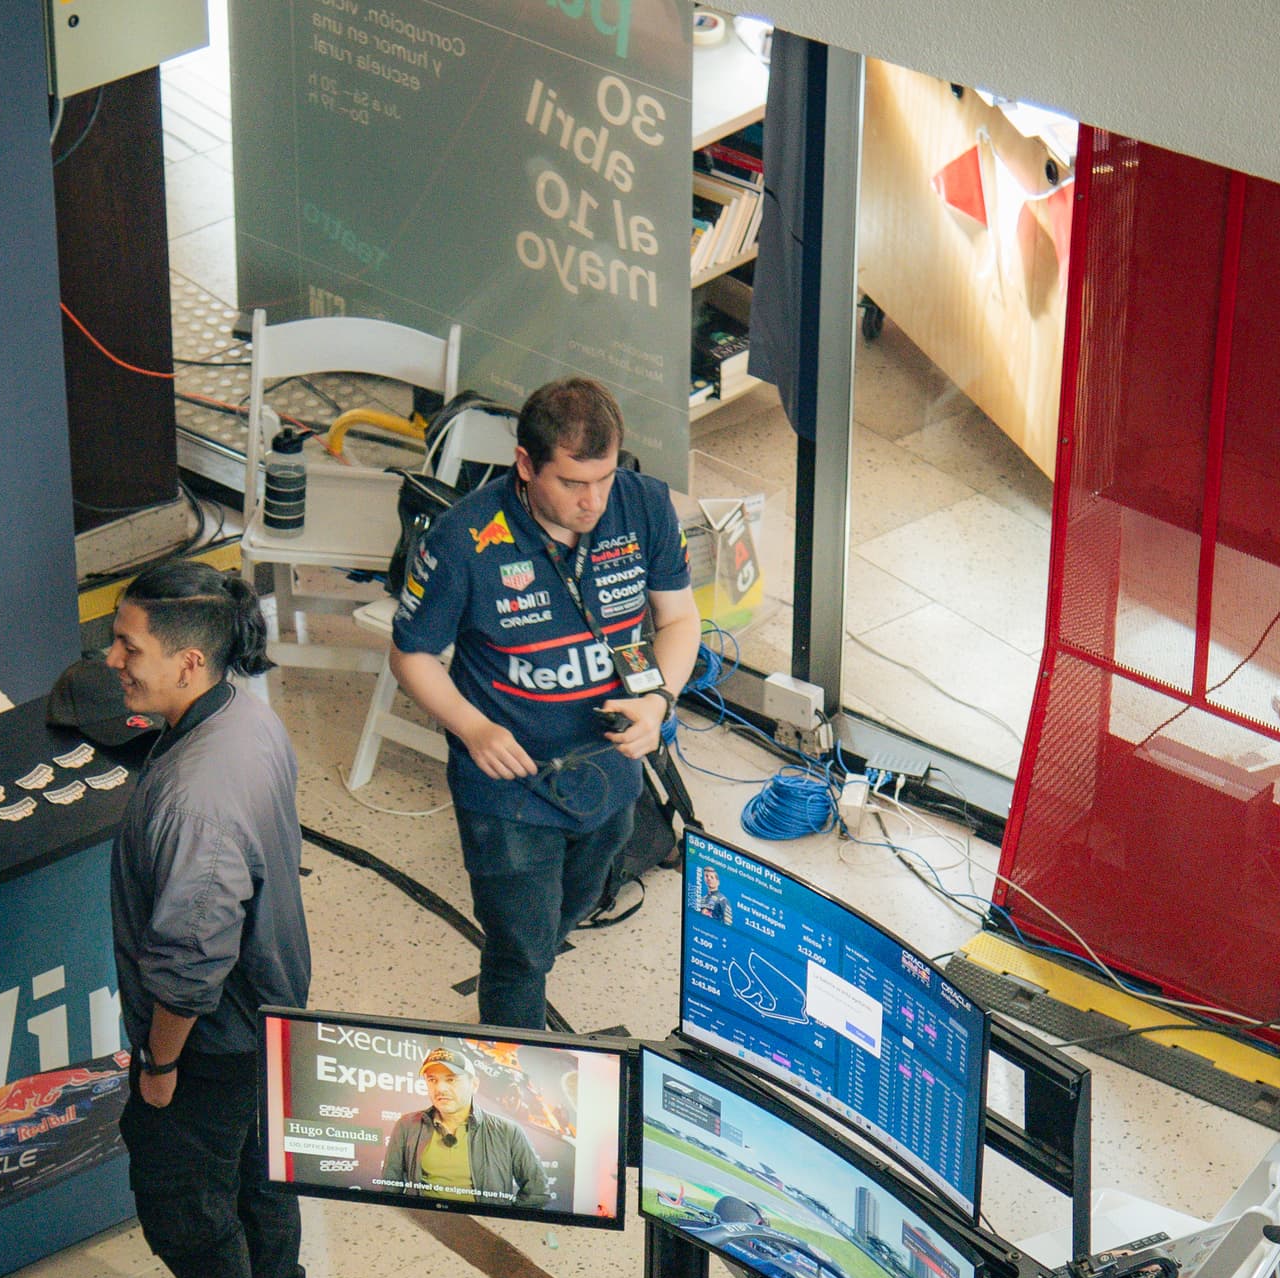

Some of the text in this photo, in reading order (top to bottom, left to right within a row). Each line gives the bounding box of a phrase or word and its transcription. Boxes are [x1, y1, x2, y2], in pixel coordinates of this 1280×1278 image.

[503, 563, 531, 575] TAG
[595, 566, 646, 588] HONDA
[496, 592, 535, 613] Mobil
[500, 611, 552, 629] ORACLE
[507, 648, 584, 690] Red
[688, 835, 705, 850] São
[707, 844, 733, 862] Paulo
[734, 855, 762, 876] Grand
[764, 869, 782, 885] Prix
[737, 901, 786, 930] Max Verstappen
[901, 950, 931, 972] ORACLE
[942, 982, 972, 1012] ORACLE
[316, 1021, 431, 1061] Executiv
[316, 1055, 429, 1096] Experie
[17, 1105, 77, 1142] Red Bull
[289, 1123, 379, 1142] Hugo Canudas
[372, 1179, 498, 1201] conoces el nivel de exigencia que
